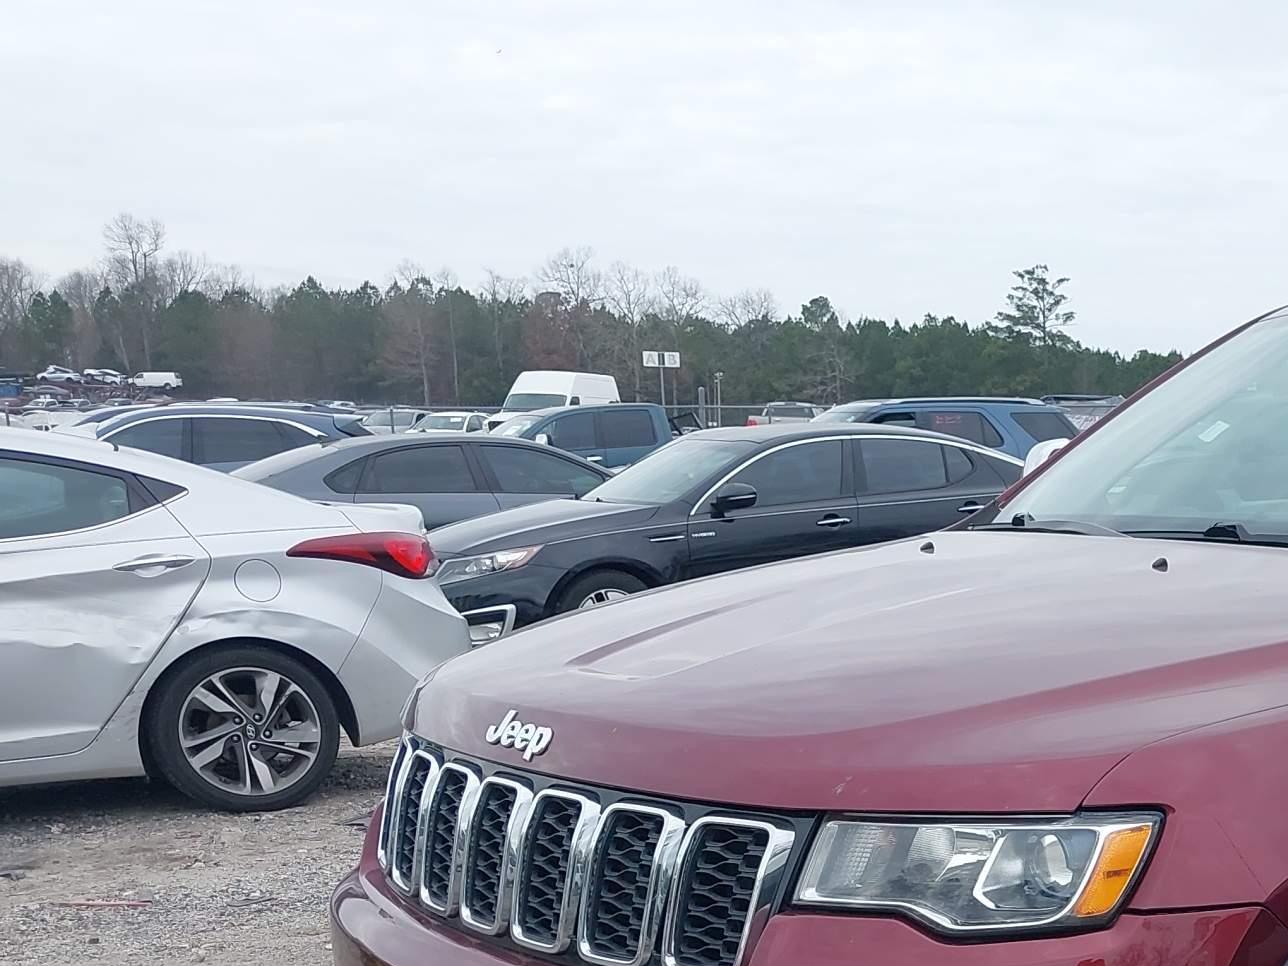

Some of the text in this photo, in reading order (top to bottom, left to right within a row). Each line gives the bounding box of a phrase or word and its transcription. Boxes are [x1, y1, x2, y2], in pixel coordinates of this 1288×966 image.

[645, 353, 678, 366] A B
[485, 709, 555, 762] Jeep
